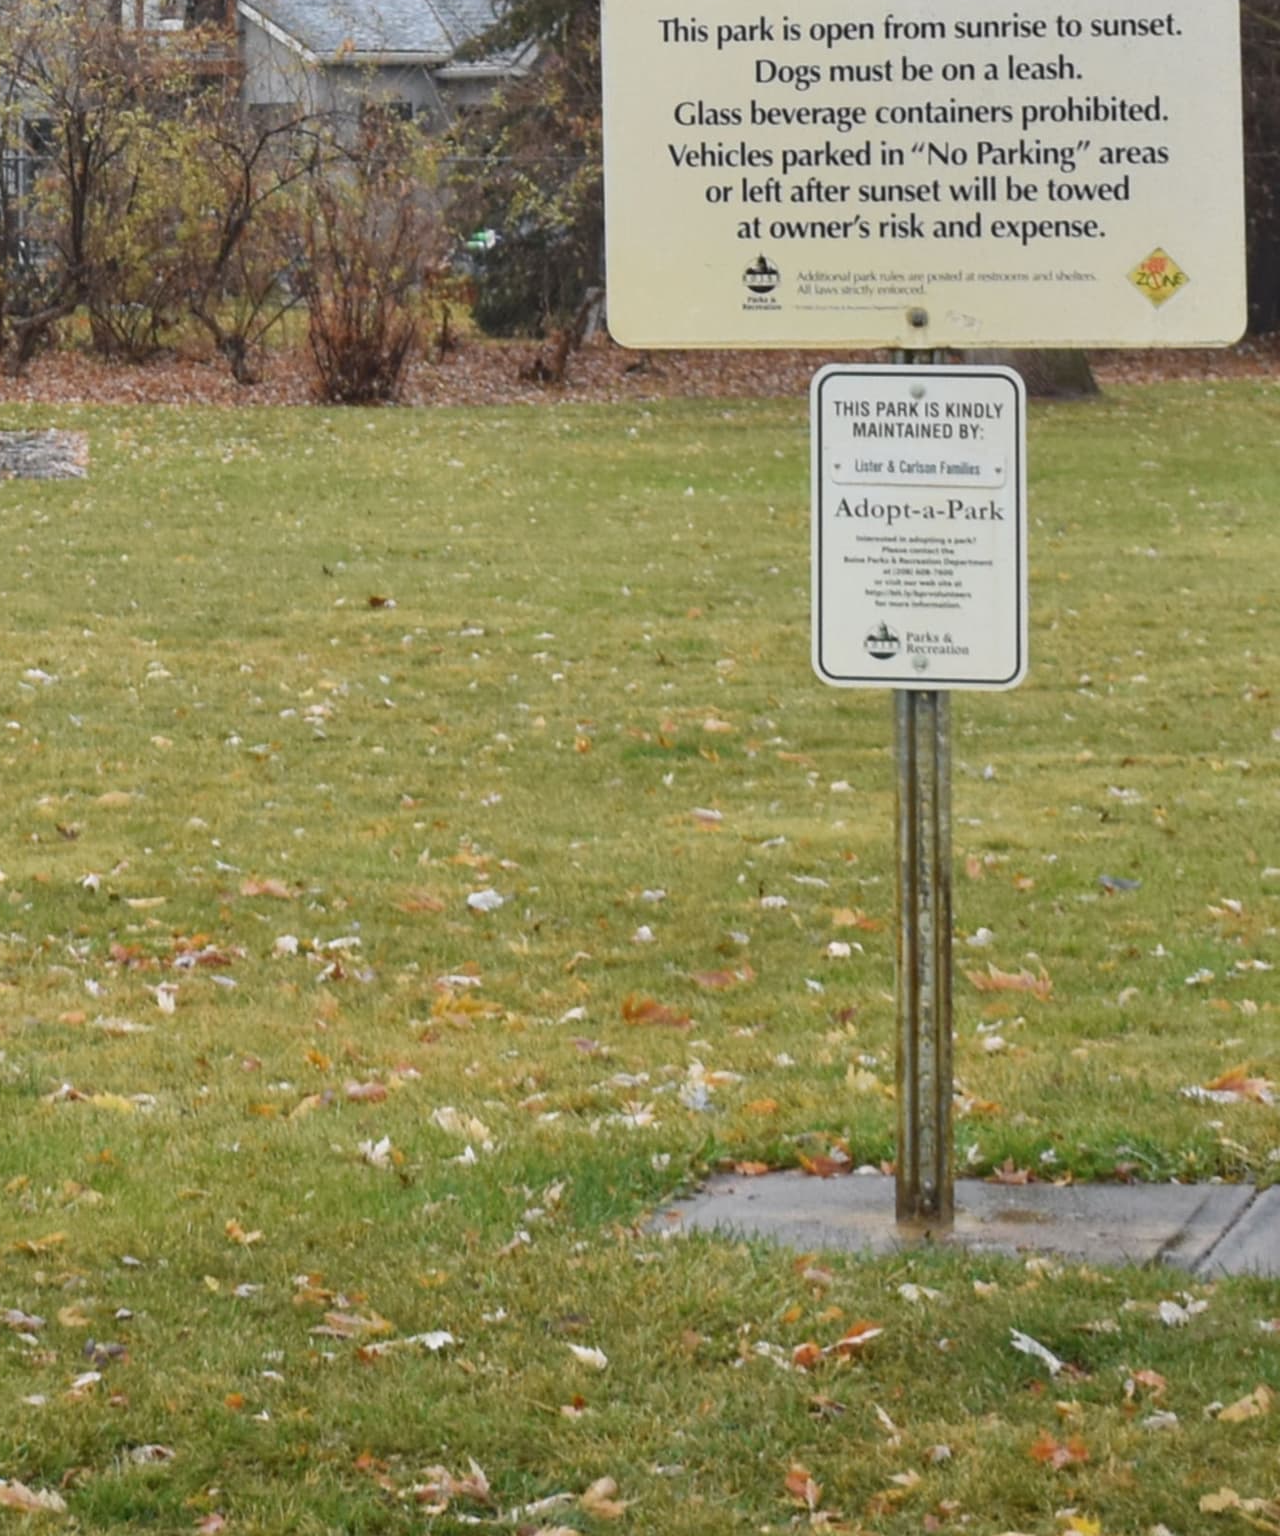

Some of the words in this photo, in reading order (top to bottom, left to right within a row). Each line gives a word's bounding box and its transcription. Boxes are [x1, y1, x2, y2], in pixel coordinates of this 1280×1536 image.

[658, 17, 708, 42] This
[717, 16, 774, 50] park
[783, 16, 801, 41] is
[809, 23, 874, 49] open
[884, 14, 946, 39] from
[954, 12, 1047, 39] sunrise
[1056, 15, 1082, 38] to
[1091, 14, 1182, 37] sunset.
[755, 59, 821, 91] Dogs
[829, 60, 893, 82] must
[902, 56, 933, 81] be
[942, 64, 975, 81] on
[984, 63, 999, 80] a
[1008, 54, 1082, 80] leash.
[674, 100, 742, 126] Glass
[751, 99, 866, 133] beverage
[875, 98, 1013, 124] containers
[1022, 96, 1168, 131] prohibited.
[668, 141, 773, 167] Vehicles
[782, 140, 871, 175] parked
[881, 141, 904, 166] in
[1099, 146, 1169, 164] areas
[706, 186, 733, 203] or
[742, 177, 782, 203] left
[790, 177, 850, 203] after
[858, 180, 941, 202] sunset
[949, 176, 996, 201] will
[1006, 176, 1038, 202] be
[1047, 175, 1129, 201] towed
[737, 217, 761, 239] at
[879, 212, 924, 238] risk
[933, 212, 981, 238] and
[991, 220, 1105, 246] expense.
[796, 270, 851, 282] Additional
[853, 270, 877, 285] park
[879, 271, 905, 282] rules
[908, 273, 924, 282] are
[927, 270, 963, 284] posted
[965, 272, 975, 282] at
[977, 272, 1029, 282] restrooms
[1032, 271, 1053, 281] and
[1056, 270, 1098, 281] shelters.
[1136, 272, 1185, 289] ZONE
[797, 284, 811, 295] All
[814, 284, 839, 295] laws
[841, 283, 874, 296] strictly
[877, 283, 929, 295] enforced.
[833, 401, 870, 417] THIS
[876, 401, 919, 418] PARK
[925, 402, 940, 418] IS
[946, 403, 1003, 419] KINDLY
[853, 422, 953, 439] MAINTAINED
[959, 424, 983, 440] BY:
[834, 497, 1004, 526] Adopt-a-Park
[906, 632, 940, 644] Parks
[942, 632, 953, 645] &
[906, 643, 969, 656] Recreation
